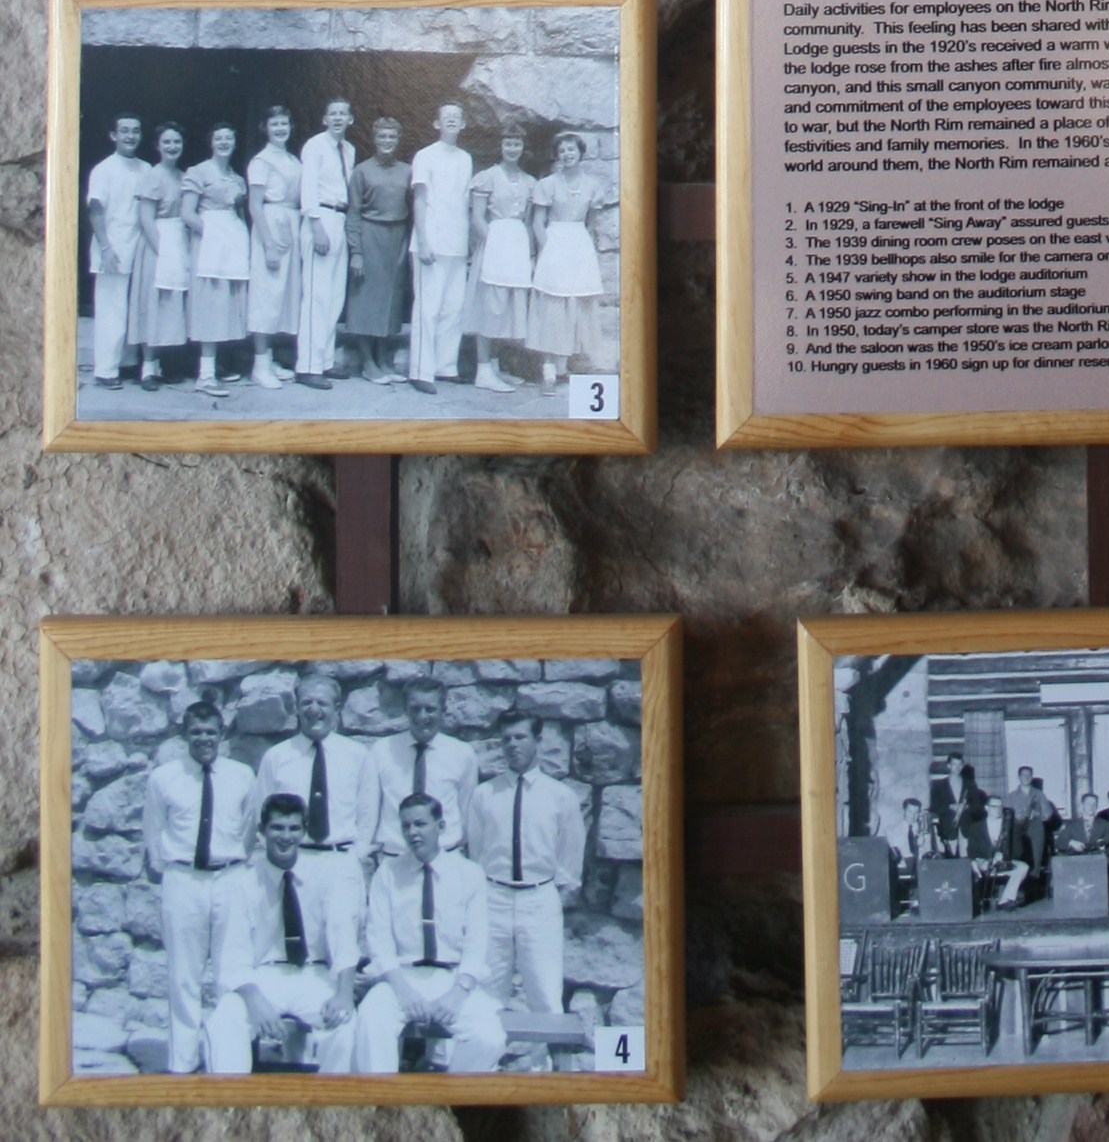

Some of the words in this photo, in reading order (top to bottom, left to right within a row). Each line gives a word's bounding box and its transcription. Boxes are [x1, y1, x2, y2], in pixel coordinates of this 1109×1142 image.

[784, 4, 820, 19] Daily
[824, 3, 886, 16] activities
[890, 2, 910, 15] for
[913, 2, 992, 17] employees
[996, 4, 1014, 13] on
[1019, 0, 1041, 13] the
[1046, 0, 1085, 13] North
[785, 43, 829, 58] Lodge
[833, 42, 881, 58] guests
[886, 41, 898, 54] in
[902, 41, 925, 54] the
[931, 40, 977, 53] 1920's
[981, 39, 1042, 53] received
[1047, 42, 1056, 52] a
[1060, 41, 1100, 51] warm
[784, 84, 840, 97] canyon,
[845, 81, 872, 94] and
[877, 80, 902, 93] this
[907, 80, 944, 93] small
[949, 82, 1001, 95] canyon
[1005, 78, 1086, 93] community,
[785, 122, 798, 134] to
[802, 123, 832, 135] war,
[837, 120, 860, 133] but
[864, 120, 887, 133] the
[891, 119, 930, 132] North
[935, 118, 964, 131] Rim
[968, 117, 1036, 131] remained
[1040, 120, 1049, 130] a
[1054, 117, 1092, 132] place
[785, 160, 824, 173] world
[828, 159, 879, 172] around
[883, 159, 923, 173] them,
[928, 158, 951, 171] the
[956, 157, 995, 170] North
[1000, 156, 1028, 169] Rim
[1033, 155, 1100, 169] remained
[787, 203, 797, 214] 1.
[804, 202, 815, 214] A
[819, 201, 851, 213] 1929
[854, 200, 911, 215] "Sing-In"
[914, 201, 927, 212] at
[930, 200, 951, 212] the
[955, 199, 984, 211] front
[988, 199, 1001, 211] of
[1004, 199, 1025, 210] the
[1029, 198, 1065, 213] lodge
[785, 220, 797, 232] 2.
[806, 220, 818, 231] In
[823, 219, 858, 232] 1929,
[863, 221, 871, 230] a
[874, 218, 925, 230] farewell
[929, 217, 963, 232] "Sing
[966, 216, 1007, 231] Away"
[1011, 216, 1063, 228] assured
[1067, 215, 1109, 230] guests
[787, 326, 798, 338] 8.
[807, 326, 819, 337] In
[825, 325, 859, 338] 1950,
[863, 324, 910, 339] today's
[914, 326, 963, 338] camper
[967, 323, 1000, 335] store
[1003, 325, 1030, 334] was
[1033, 322, 1054, 334] the
[1058, 321, 1094, 333] North
[787, 344, 798, 355] 9.
[806, 343, 832, 355] And
[836, 343, 857, 354] the
[861, 342, 904, 354] saloon
[907, 344, 934, 353] was
[938, 341, 959, 353] the
[963, 340, 1006, 352] 1950's
[1009, 340, 1029, 352] ice
[1032, 341, 1073, 351] cream
[788, 361, 806, 373] 10.
[812, 361, 859, 375] Hungry
[862, 360, 906, 375] guests
[910, 359, 921, 371] in
[926, 359, 958, 370] 1960
[962, 358, 989, 373] sign
[993, 360, 1010, 372] up
[1013, 357, 1031, 369] for
[1034, 357, 1075, 369] dinner
[590, 382, 604, 413] 3
[844, 863, 866, 891] G
[615, 1034, 631, 1064] 4
